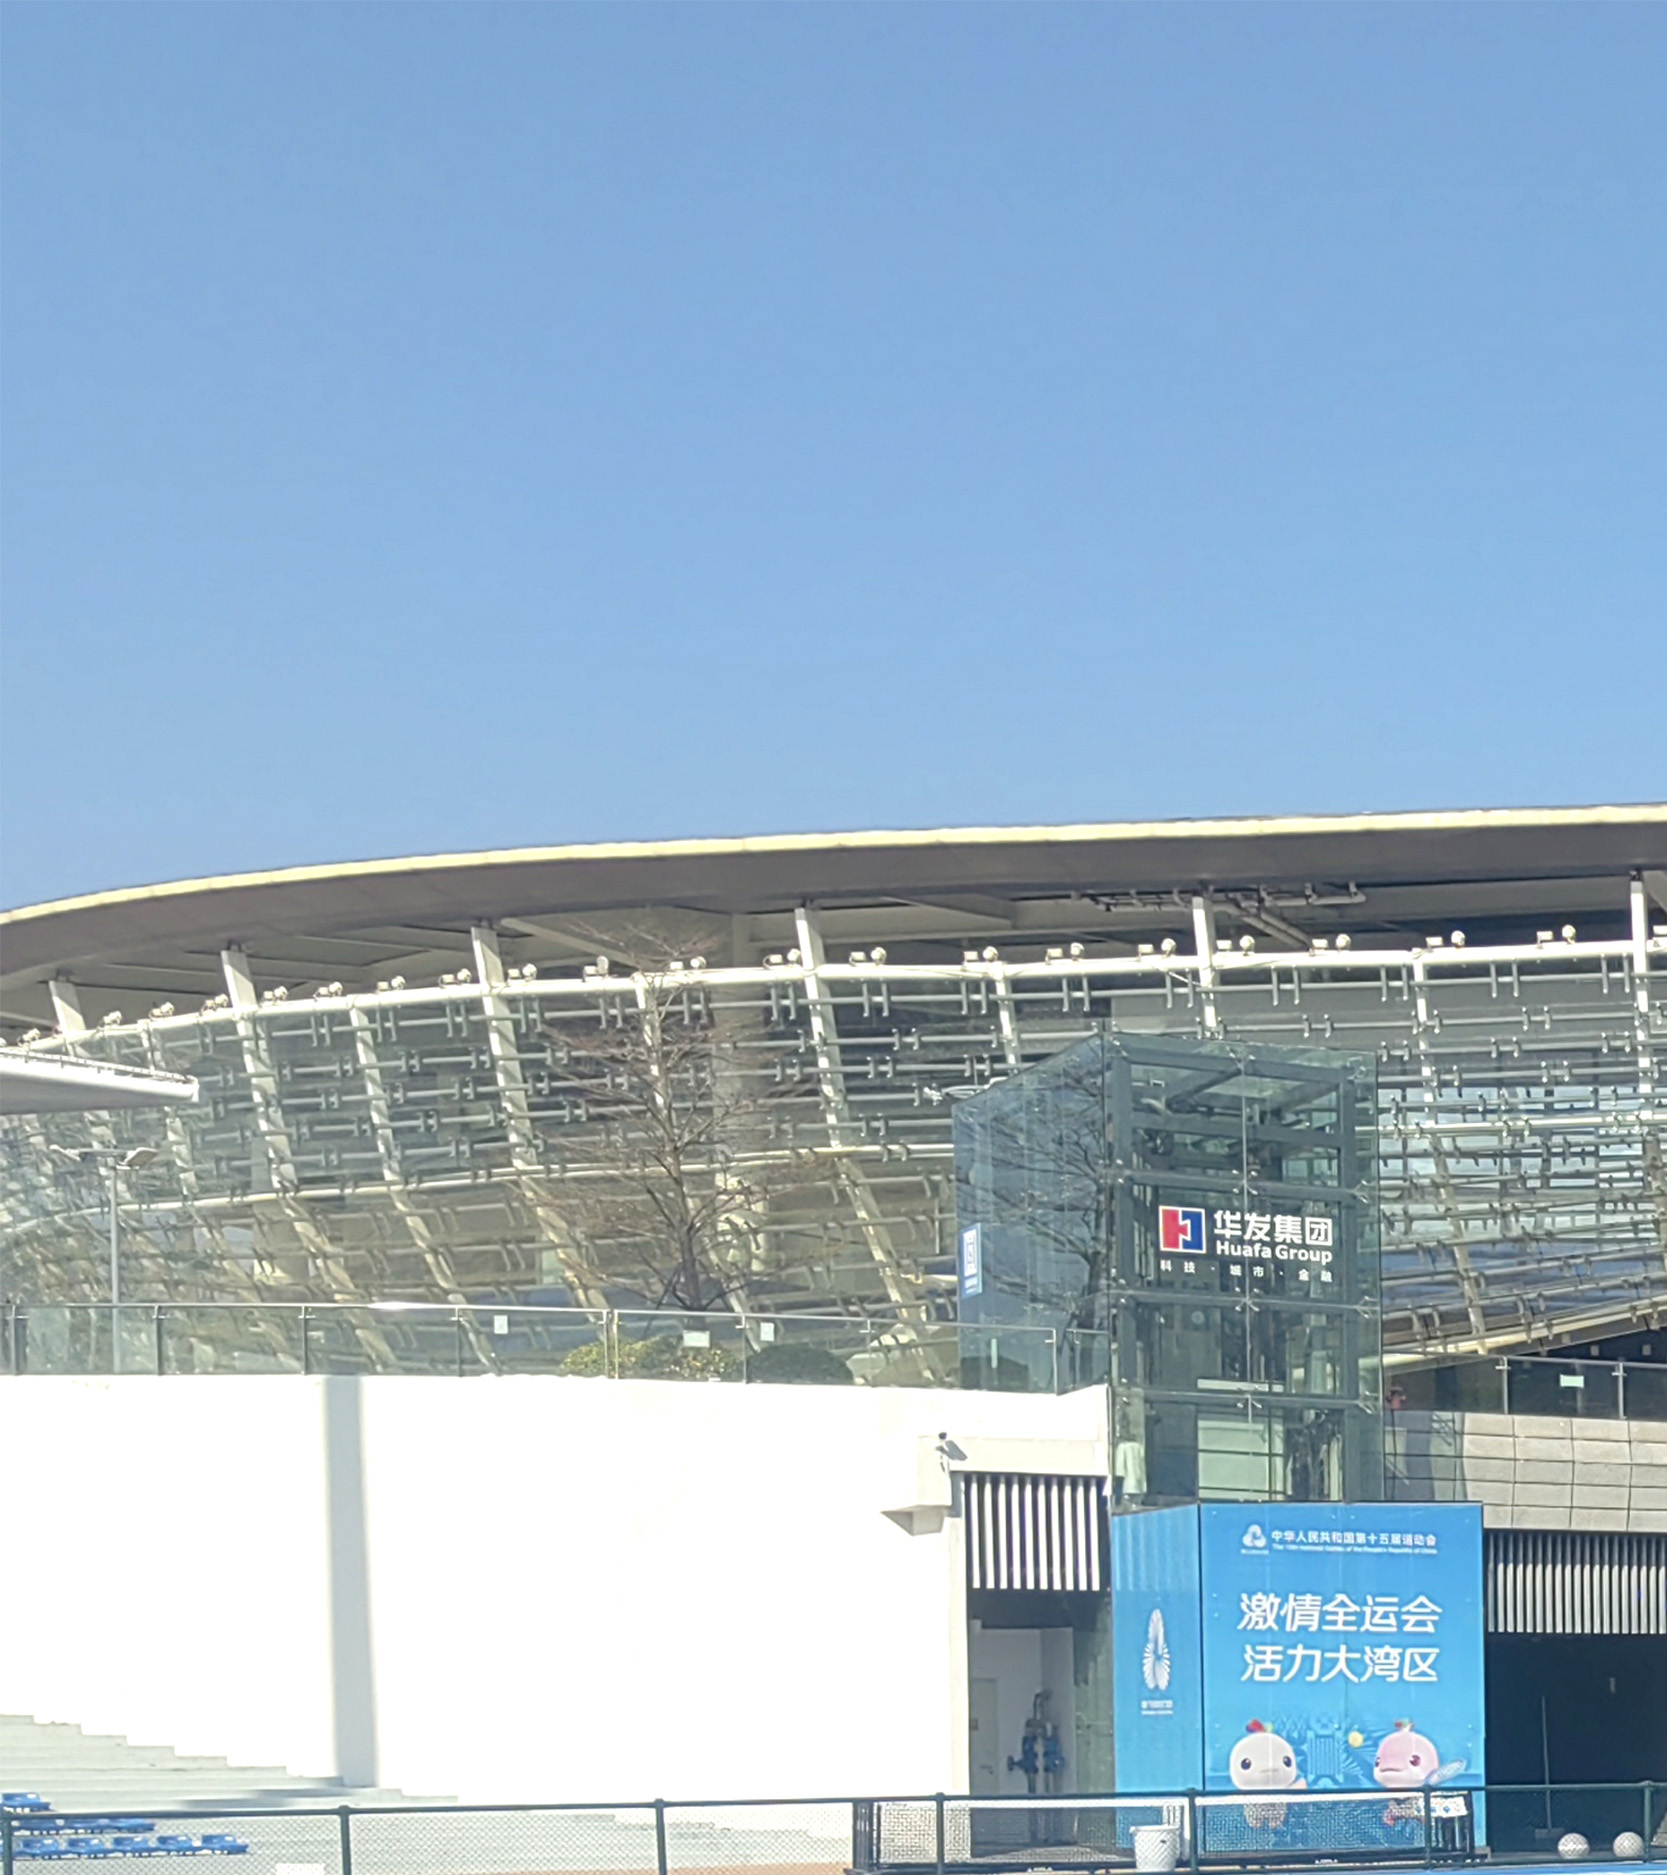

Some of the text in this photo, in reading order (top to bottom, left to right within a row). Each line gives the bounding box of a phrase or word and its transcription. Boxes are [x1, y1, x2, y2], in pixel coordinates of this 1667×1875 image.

[1214, 1210, 1333, 1247] 华发集团
[1216, 1240, 1333, 1266] Huafa Group
[1237, 1592, 1443, 1633] 激情全运会
[1240, 1643, 1440, 1683] 活力大湾区
